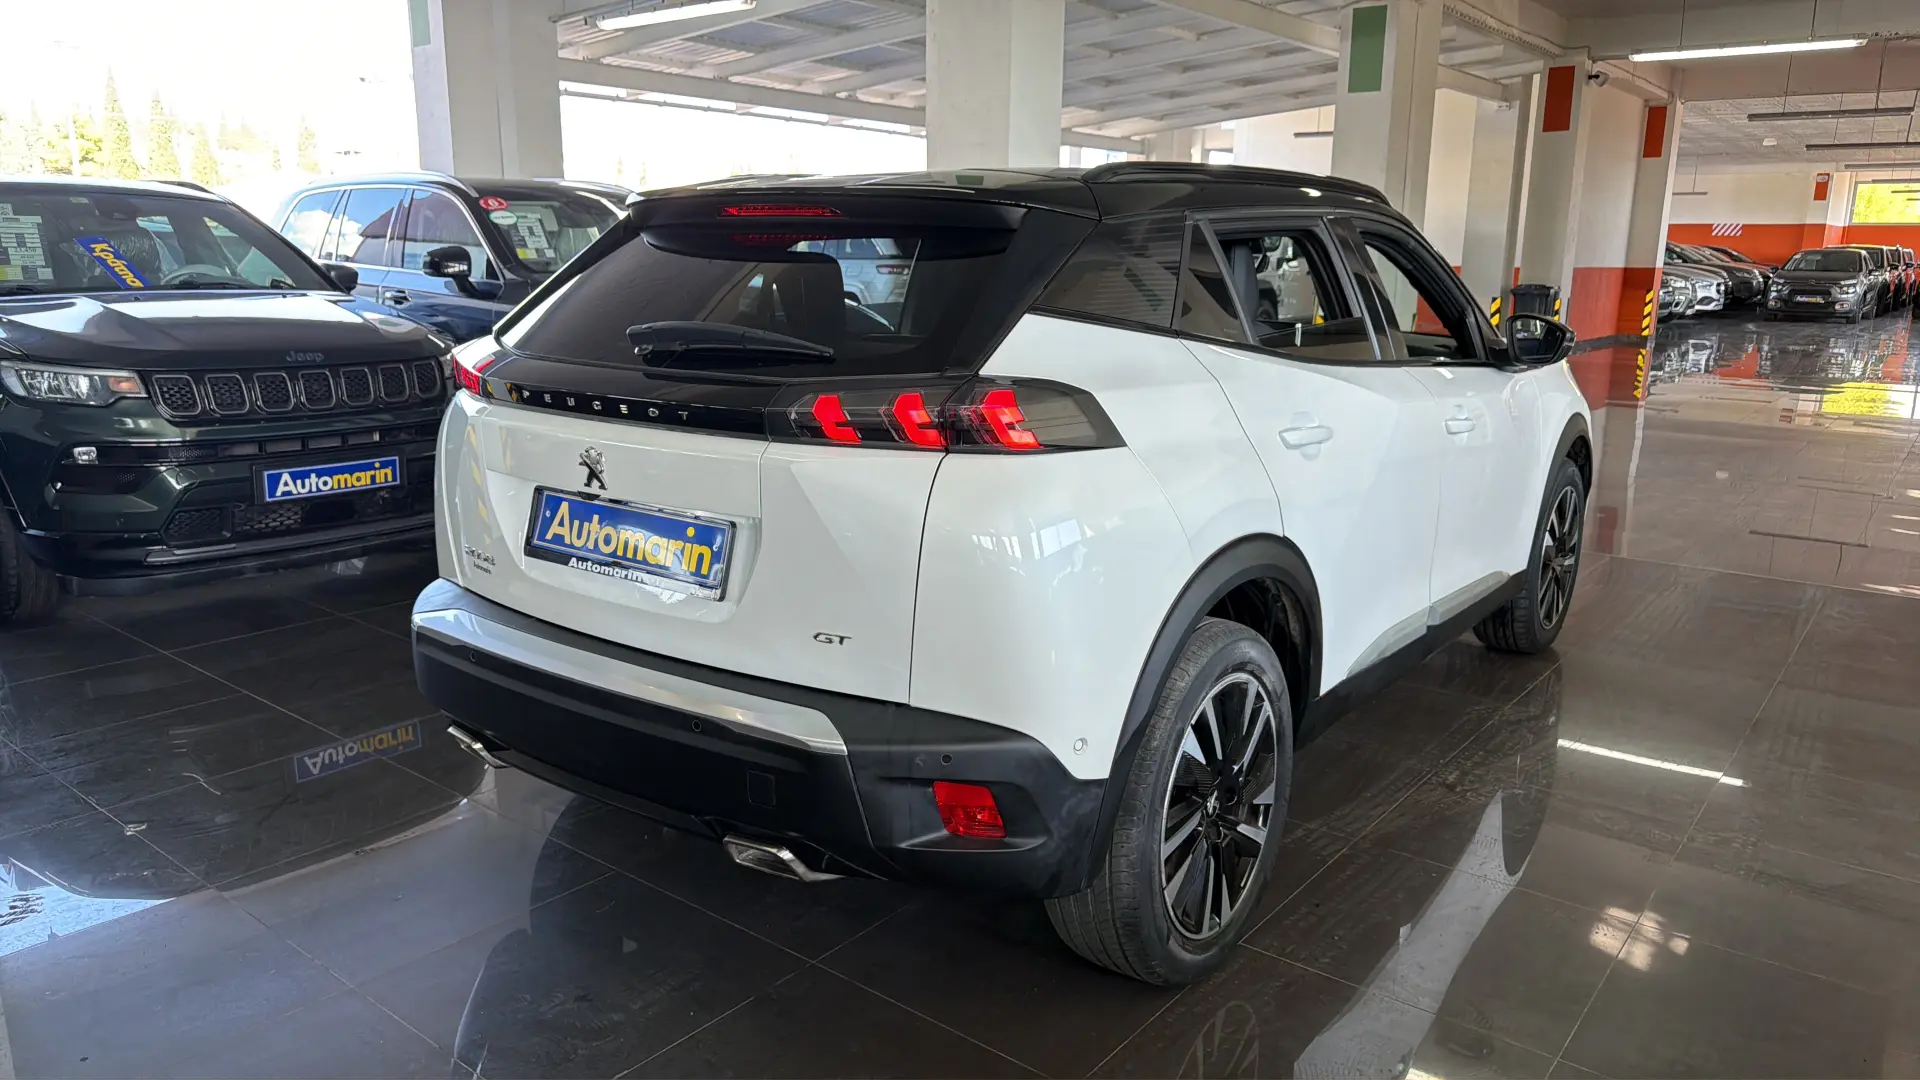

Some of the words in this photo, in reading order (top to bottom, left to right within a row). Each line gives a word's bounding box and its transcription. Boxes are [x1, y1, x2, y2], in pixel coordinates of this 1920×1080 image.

[285, 350, 325, 363] Jeep
[521, 389, 689, 421] PEUGEOT
[275, 461, 393, 497] Automarin
[545, 500, 713, 576] Automarin
[812, 631, 853, 646] GT
